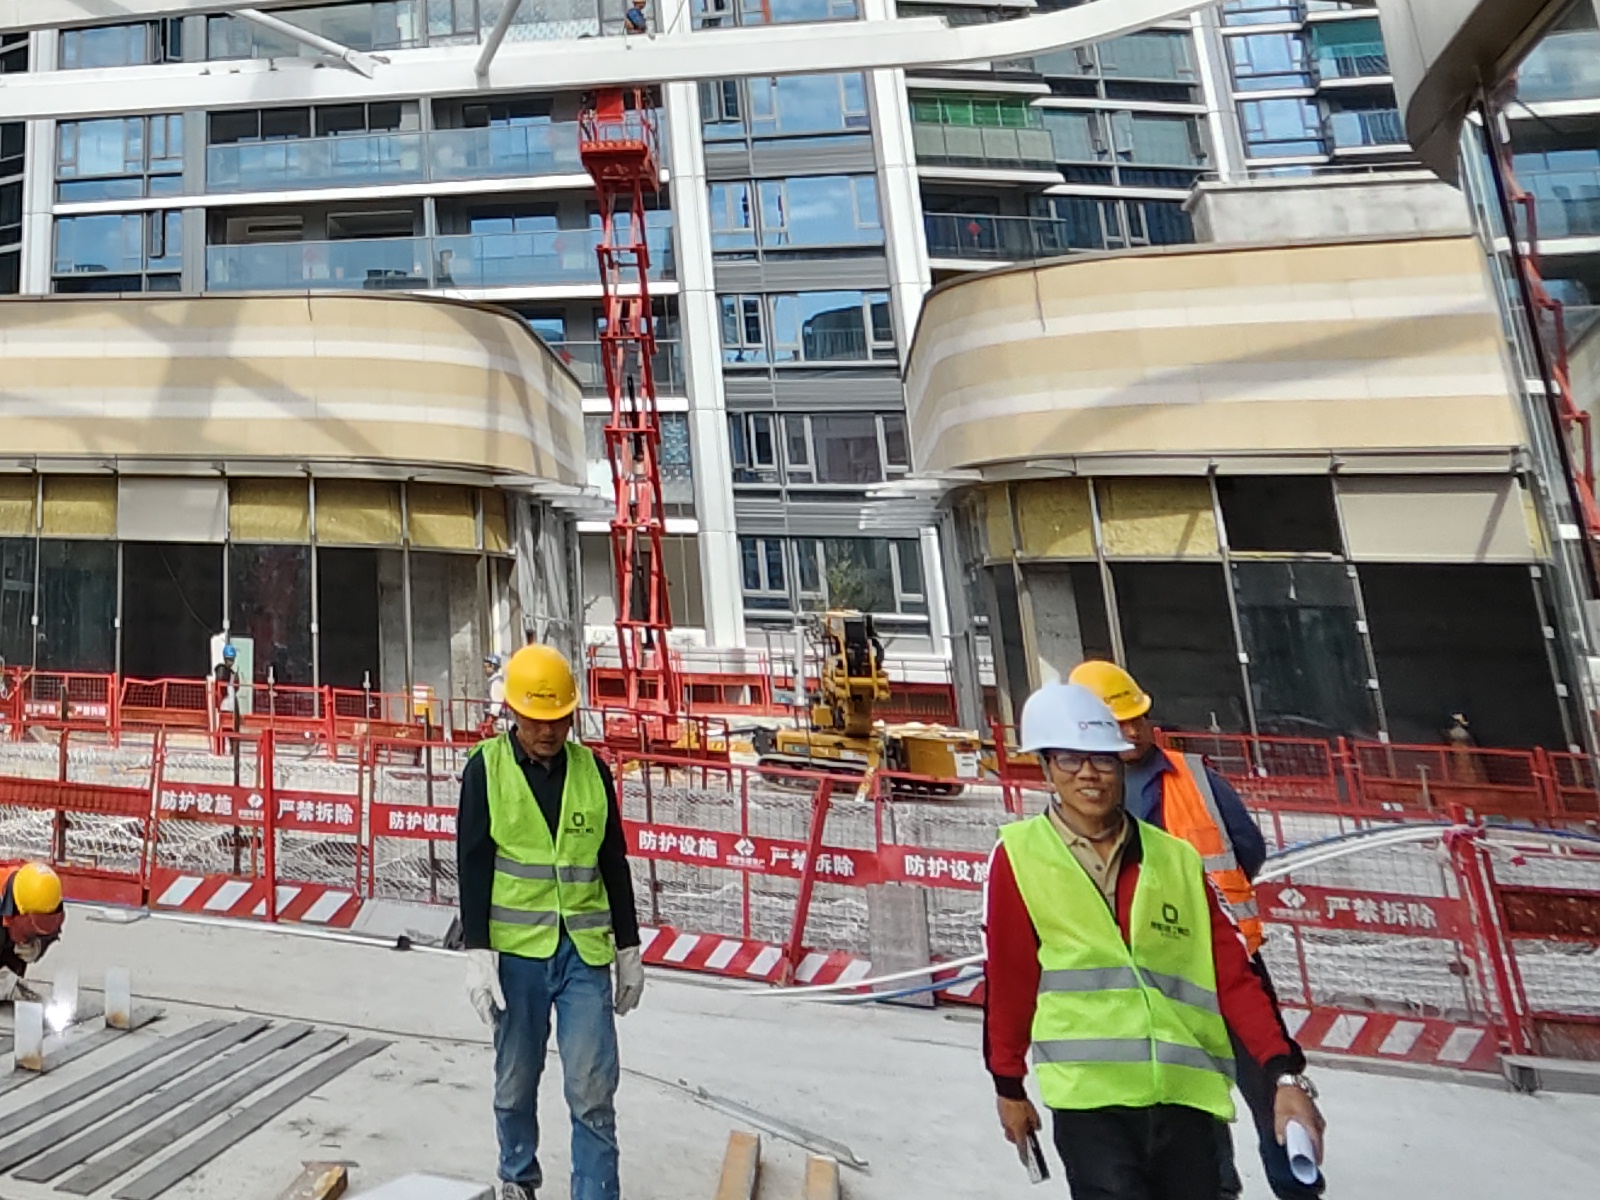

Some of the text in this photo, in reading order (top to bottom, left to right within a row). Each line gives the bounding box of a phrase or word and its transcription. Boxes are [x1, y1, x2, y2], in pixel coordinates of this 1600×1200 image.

[161, 791, 232, 816] 防护设施
[277, 798, 354, 825] 严禁拆除
[389, 811, 457, 834] 防护设施
[639, 830, 718, 859] 防护设施
[1325, 896, 1437, 928] 严禁拆除
